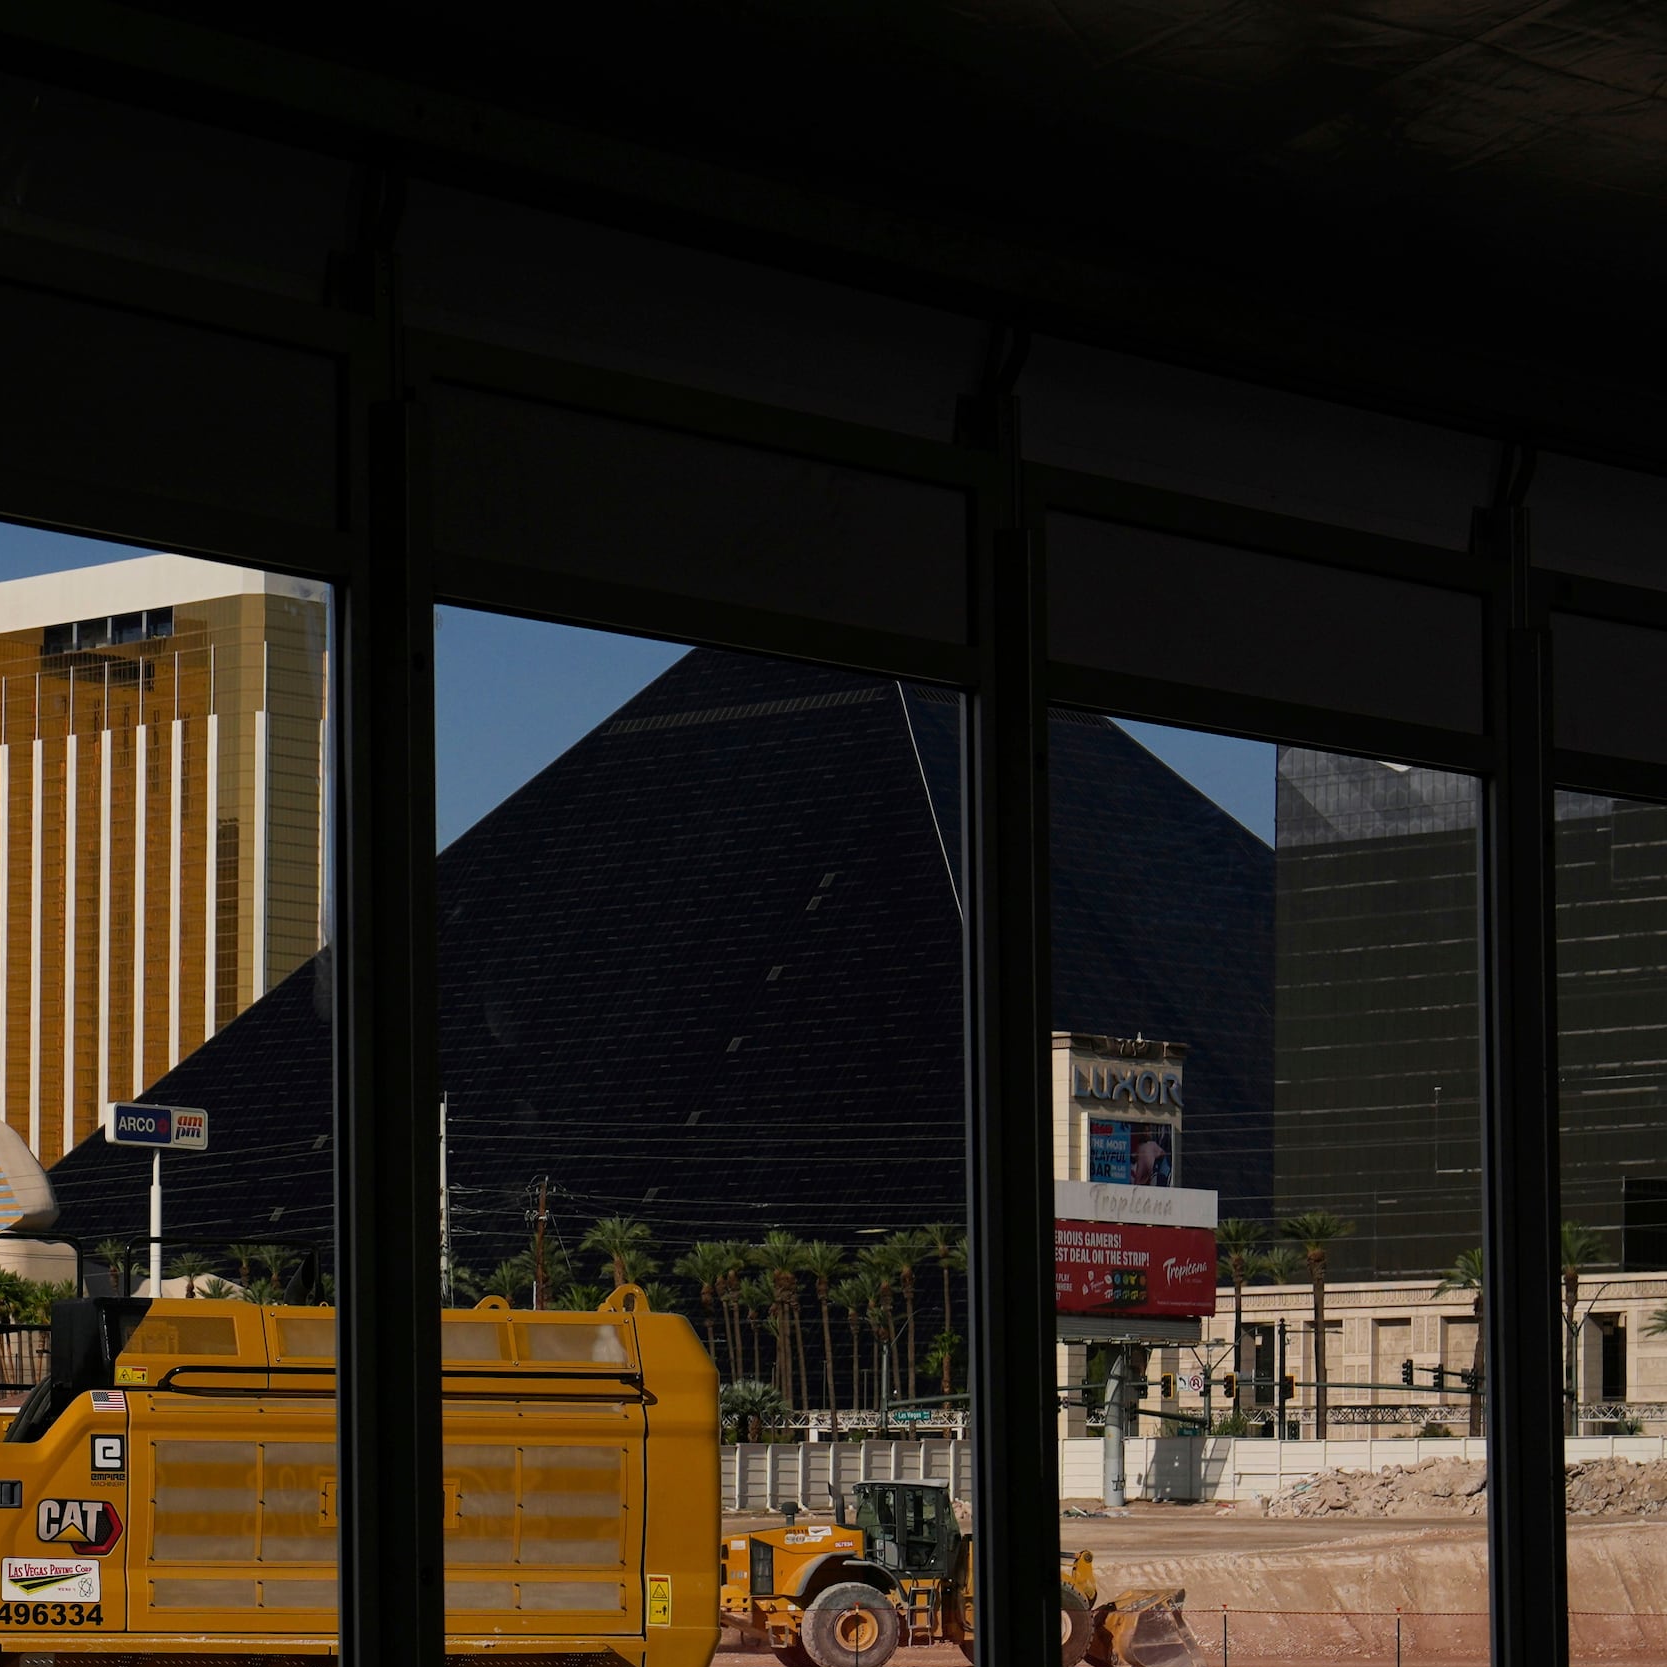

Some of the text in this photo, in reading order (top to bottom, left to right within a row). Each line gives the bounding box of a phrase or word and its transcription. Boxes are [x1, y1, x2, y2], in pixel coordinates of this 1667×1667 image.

[1071, 1064, 1184, 1107] LUXOR
[118, 1116, 155, 1133] ARCO
[1085, 1232, 1121, 1248] GAMERS!
[1070, 1249, 1090, 1263] DEAL
[1092, 1250, 1104, 1263] ON
[1105, 1251, 1121, 1265] THE
[1123, 1252, 1149, 1266] STRIP!
[1163, 1257, 1207, 1286] Tropicana
[39, 1499, 103, 1543] CAT
